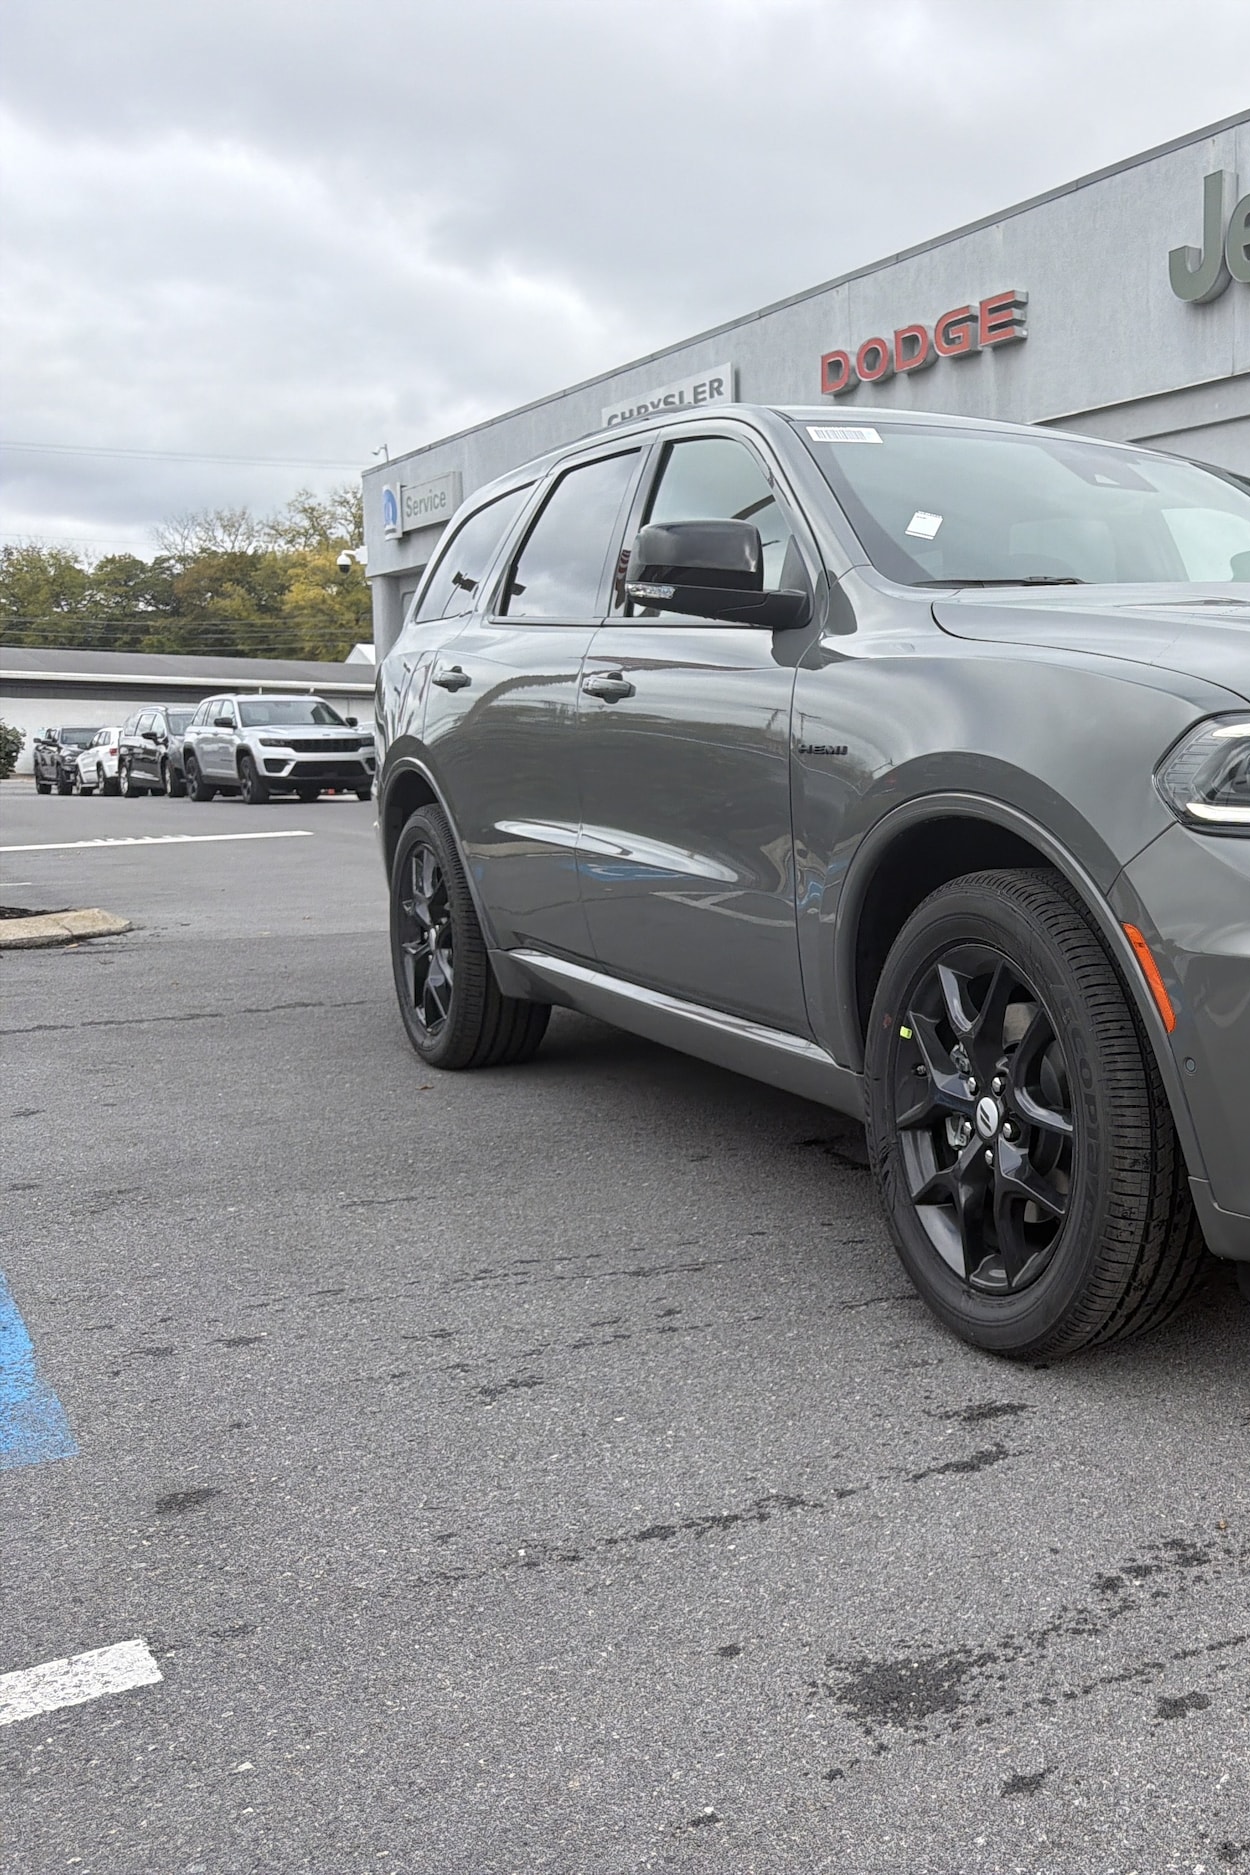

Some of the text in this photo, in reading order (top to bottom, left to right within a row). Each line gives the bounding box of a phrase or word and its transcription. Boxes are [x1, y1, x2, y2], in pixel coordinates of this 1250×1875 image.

[821, 290, 1028, 394] DODGE
[405, 489, 447, 518] Service
[798, 744, 848, 755] HEMI
